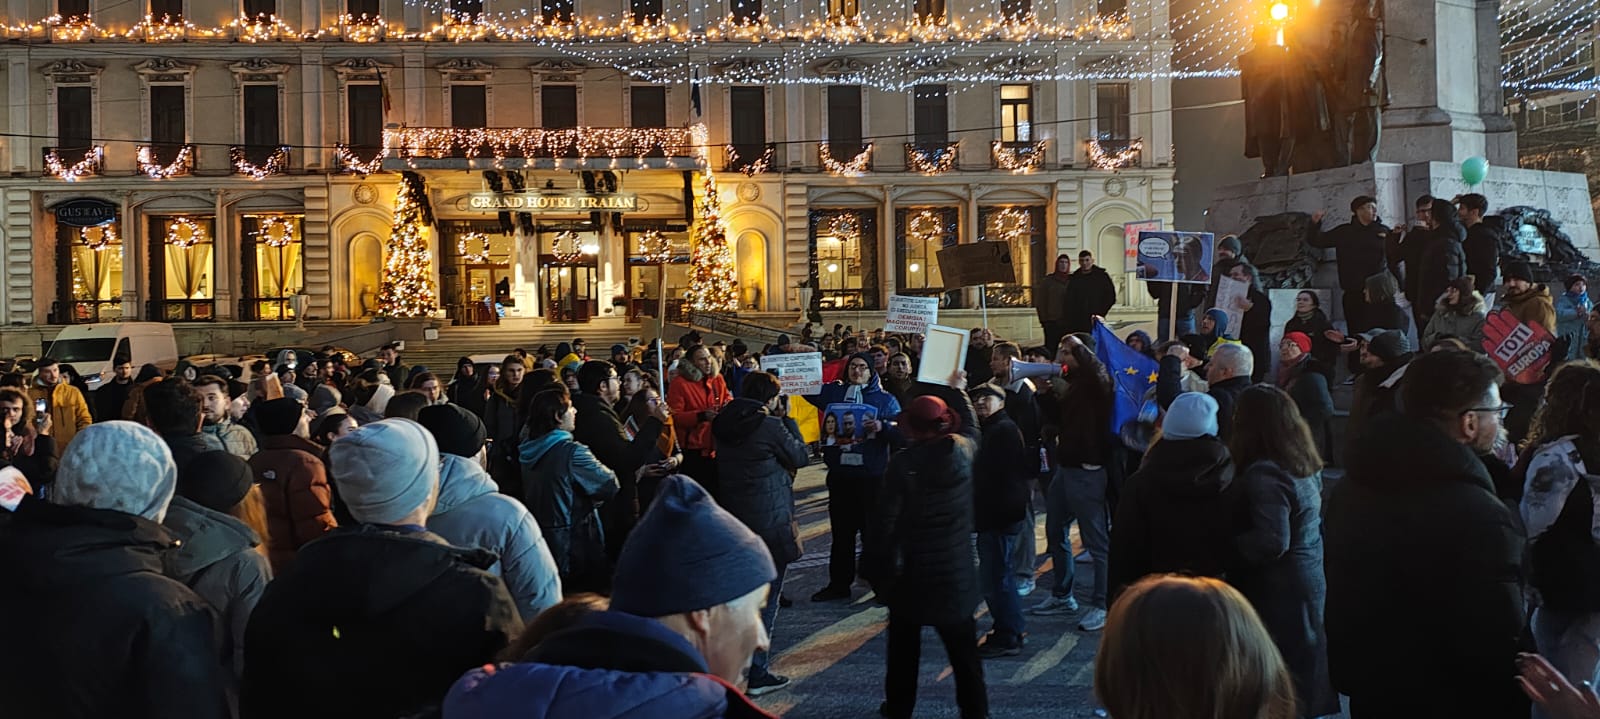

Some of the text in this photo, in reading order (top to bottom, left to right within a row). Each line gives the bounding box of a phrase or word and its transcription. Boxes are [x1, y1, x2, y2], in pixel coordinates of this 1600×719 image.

[470, 196, 634, 209] GRAND HOTEL TRAIAN
[1507, 340, 1551, 376] EUROPA
